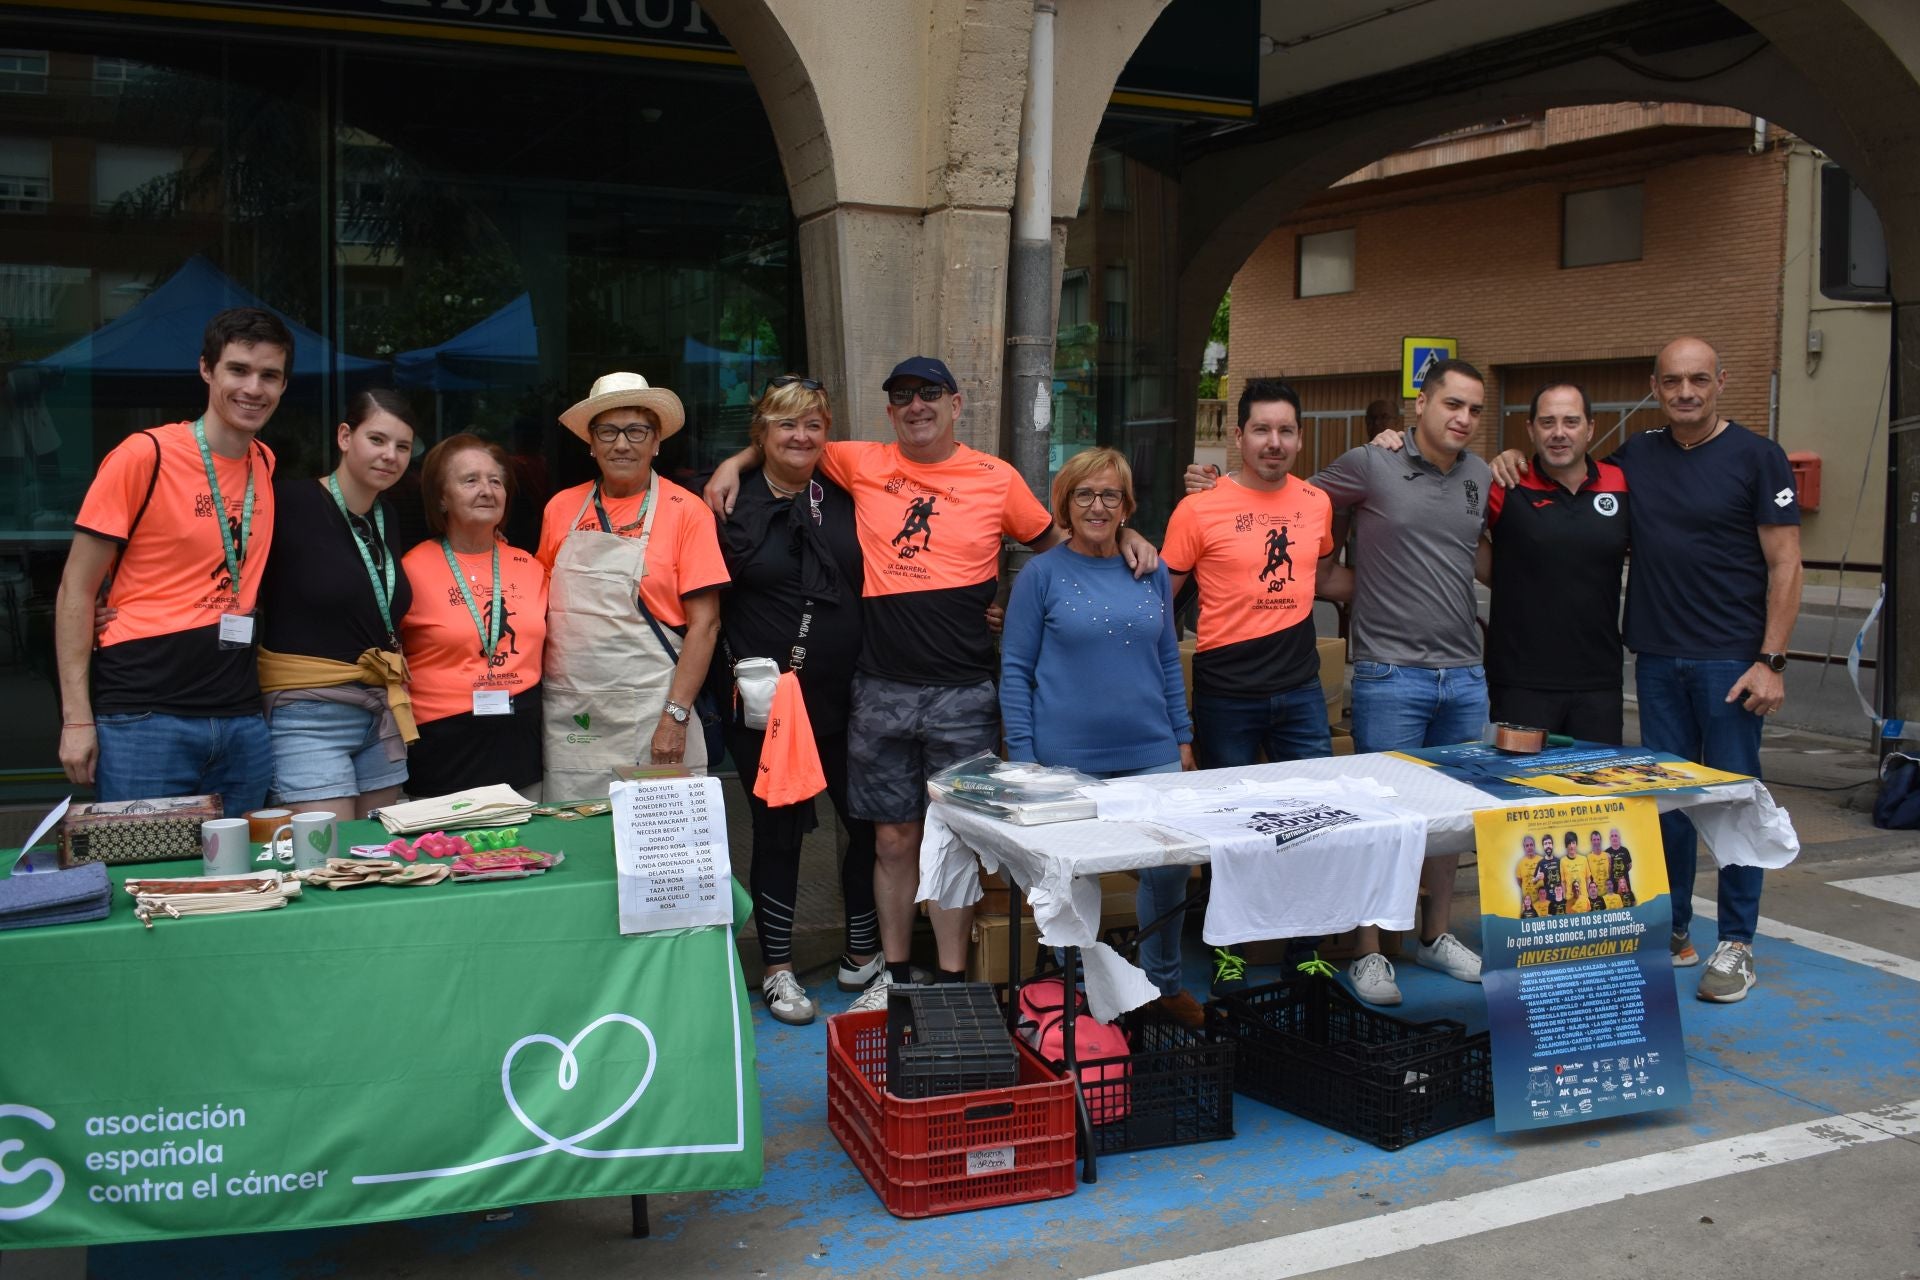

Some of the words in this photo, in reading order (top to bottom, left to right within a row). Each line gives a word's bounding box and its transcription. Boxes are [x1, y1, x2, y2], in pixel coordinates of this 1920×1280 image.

[895, 564, 927, 573] CARRERA
[798, 614, 812, 638] BIMBA
[638, 786, 657, 794] BOLSO
[635, 794, 654, 802] BOLSO
[1506, 811, 1530, 822] RETO
[1533, 808, 1555, 820] 2330
[1571, 806, 1588, 816] POR
[1590, 804, 1601, 814] LA
[1604, 801, 1625, 812] VIDA
[658, 818, 689, 826] MACRAME
[658, 859, 694, 868] ORDENADOR
[648, 868, 684, 876] DELANTALES
[646, 895, 666, 903] BRAGA
[1521, 920, 1530, 933] Lo
[1532, 919, 1546, 932] que
[1547, 920, 1557, 929] no
[1559, 919, 1568, 928] se
[1570, 918, 1580, 927] ve
[1581, 916, 1591, 926] no
[1592, 915, 1602, 924] se
[1604, 911, 1633, 924] conoce,
[1507, 936, 1515, 948] lo
[1516, 937, 1532, 949] que
[1534, 935, 1543, 945] no
[1545, 934, 1554, 944] se
[1555, 930, 1586, 944] conoce,
[1588, 928, 1597, 939] no
[1599, 927, 1608, 937] se
[1610, 922, 1647, 937] investiga.
[1517, 939, 1618, 968] ¡INVESTIGACIÓN
[1620, 938, 1639, 952] YA!
[1582, 962, 1606, 970] CALZADA
[1546, 974, 1572, 982] CAMEROS
[1521, 984, 1553, 993] OJACASTRO
[1528, 998, 1560, 1006] NAVARRETE
[1549, 1002, 1578, 1011] AGONCILLO
[1529, 1012, 1560, 1021] TORRECILLA
[1533, 1026, 1565, 1035] ALCANADRE
[1537, 1040, 1570, 1048] CALAHORRA
[1571, 1036, 1592, 1044] CARTES
[85, 1104, 246, 1136] asociación
[85, 1139, 223, 1175] española
[88, 1177, 183, 1203] contra
[192, 1173, 217, 1199] el
[226, 1169, 328, 1196] cáncer
